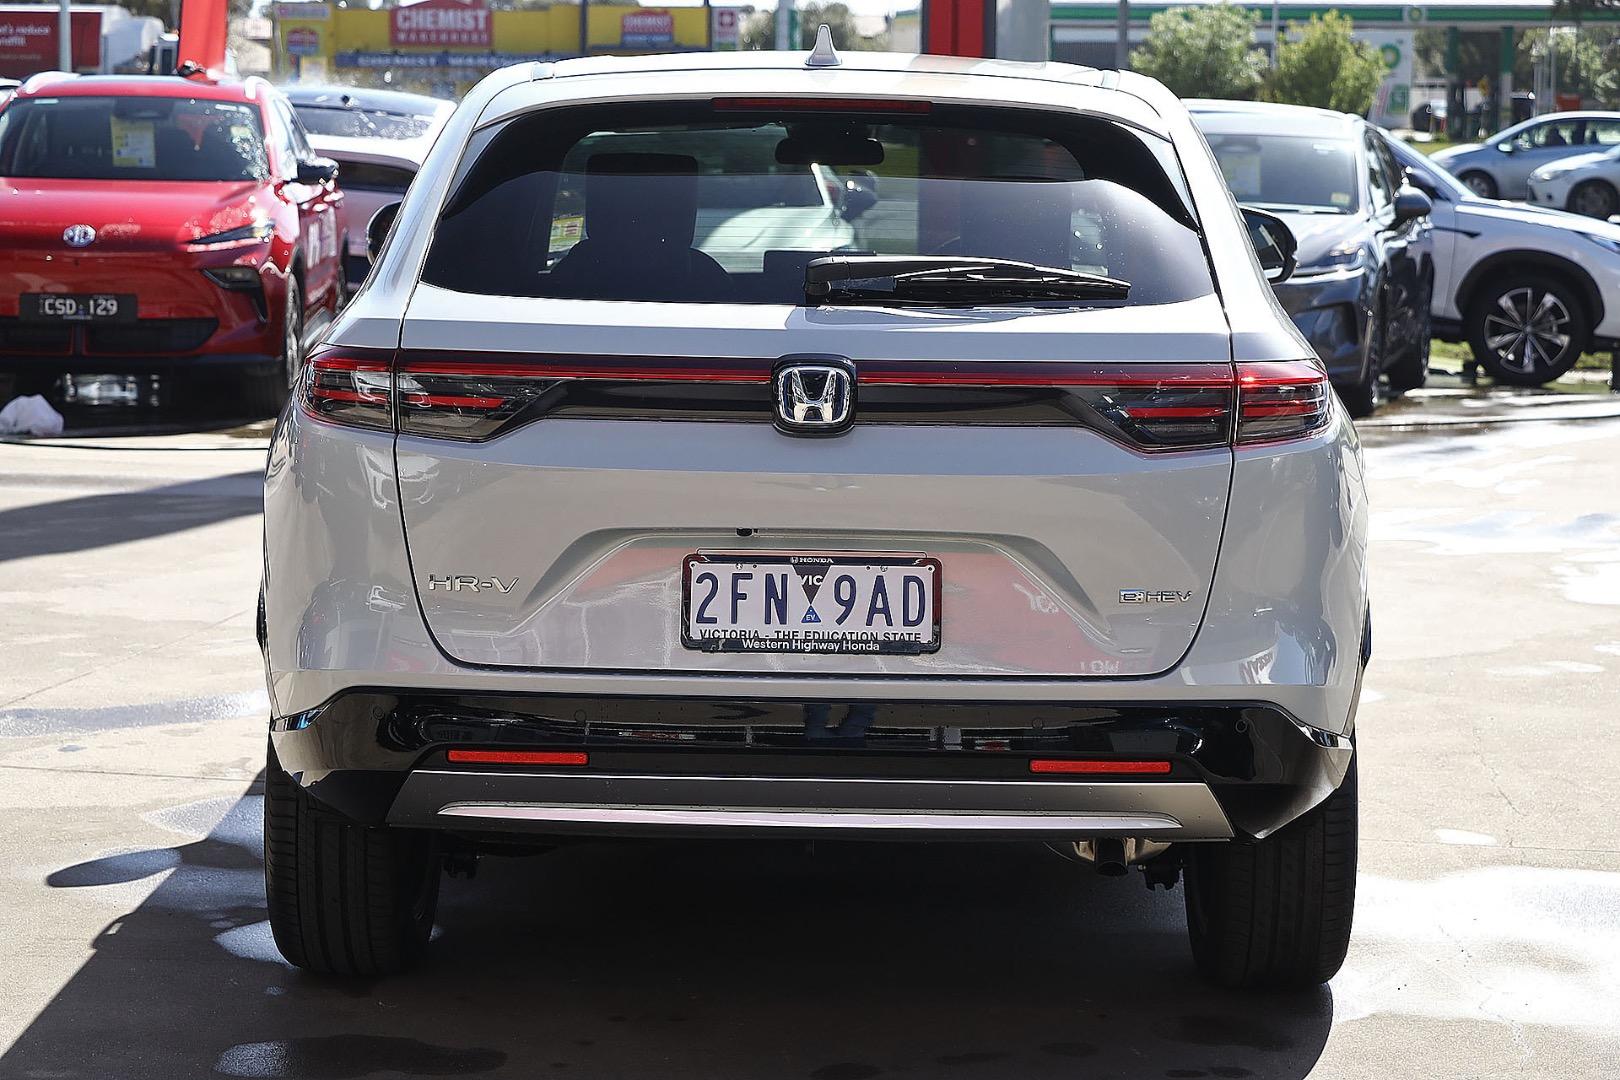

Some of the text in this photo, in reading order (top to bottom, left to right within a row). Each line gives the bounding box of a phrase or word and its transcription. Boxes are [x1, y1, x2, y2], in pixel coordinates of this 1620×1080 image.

[397, 9, 488, 30] CHEMIST
[44, 299, 118, 316] CSD 129
[428, 574, 520, 594] HR-V
[801, 574, 824, 586] VIC
[696, 572, 926, 627] 2FN 9AD
[700, 629, 760, 639] VICTORIA
[775, 630, 799, 640] THE
[804, 631, 878, 641] EDUCATION
[883, 632, 921, 641] STATE
[742, 639, 880, 652] Western Highway Honda
